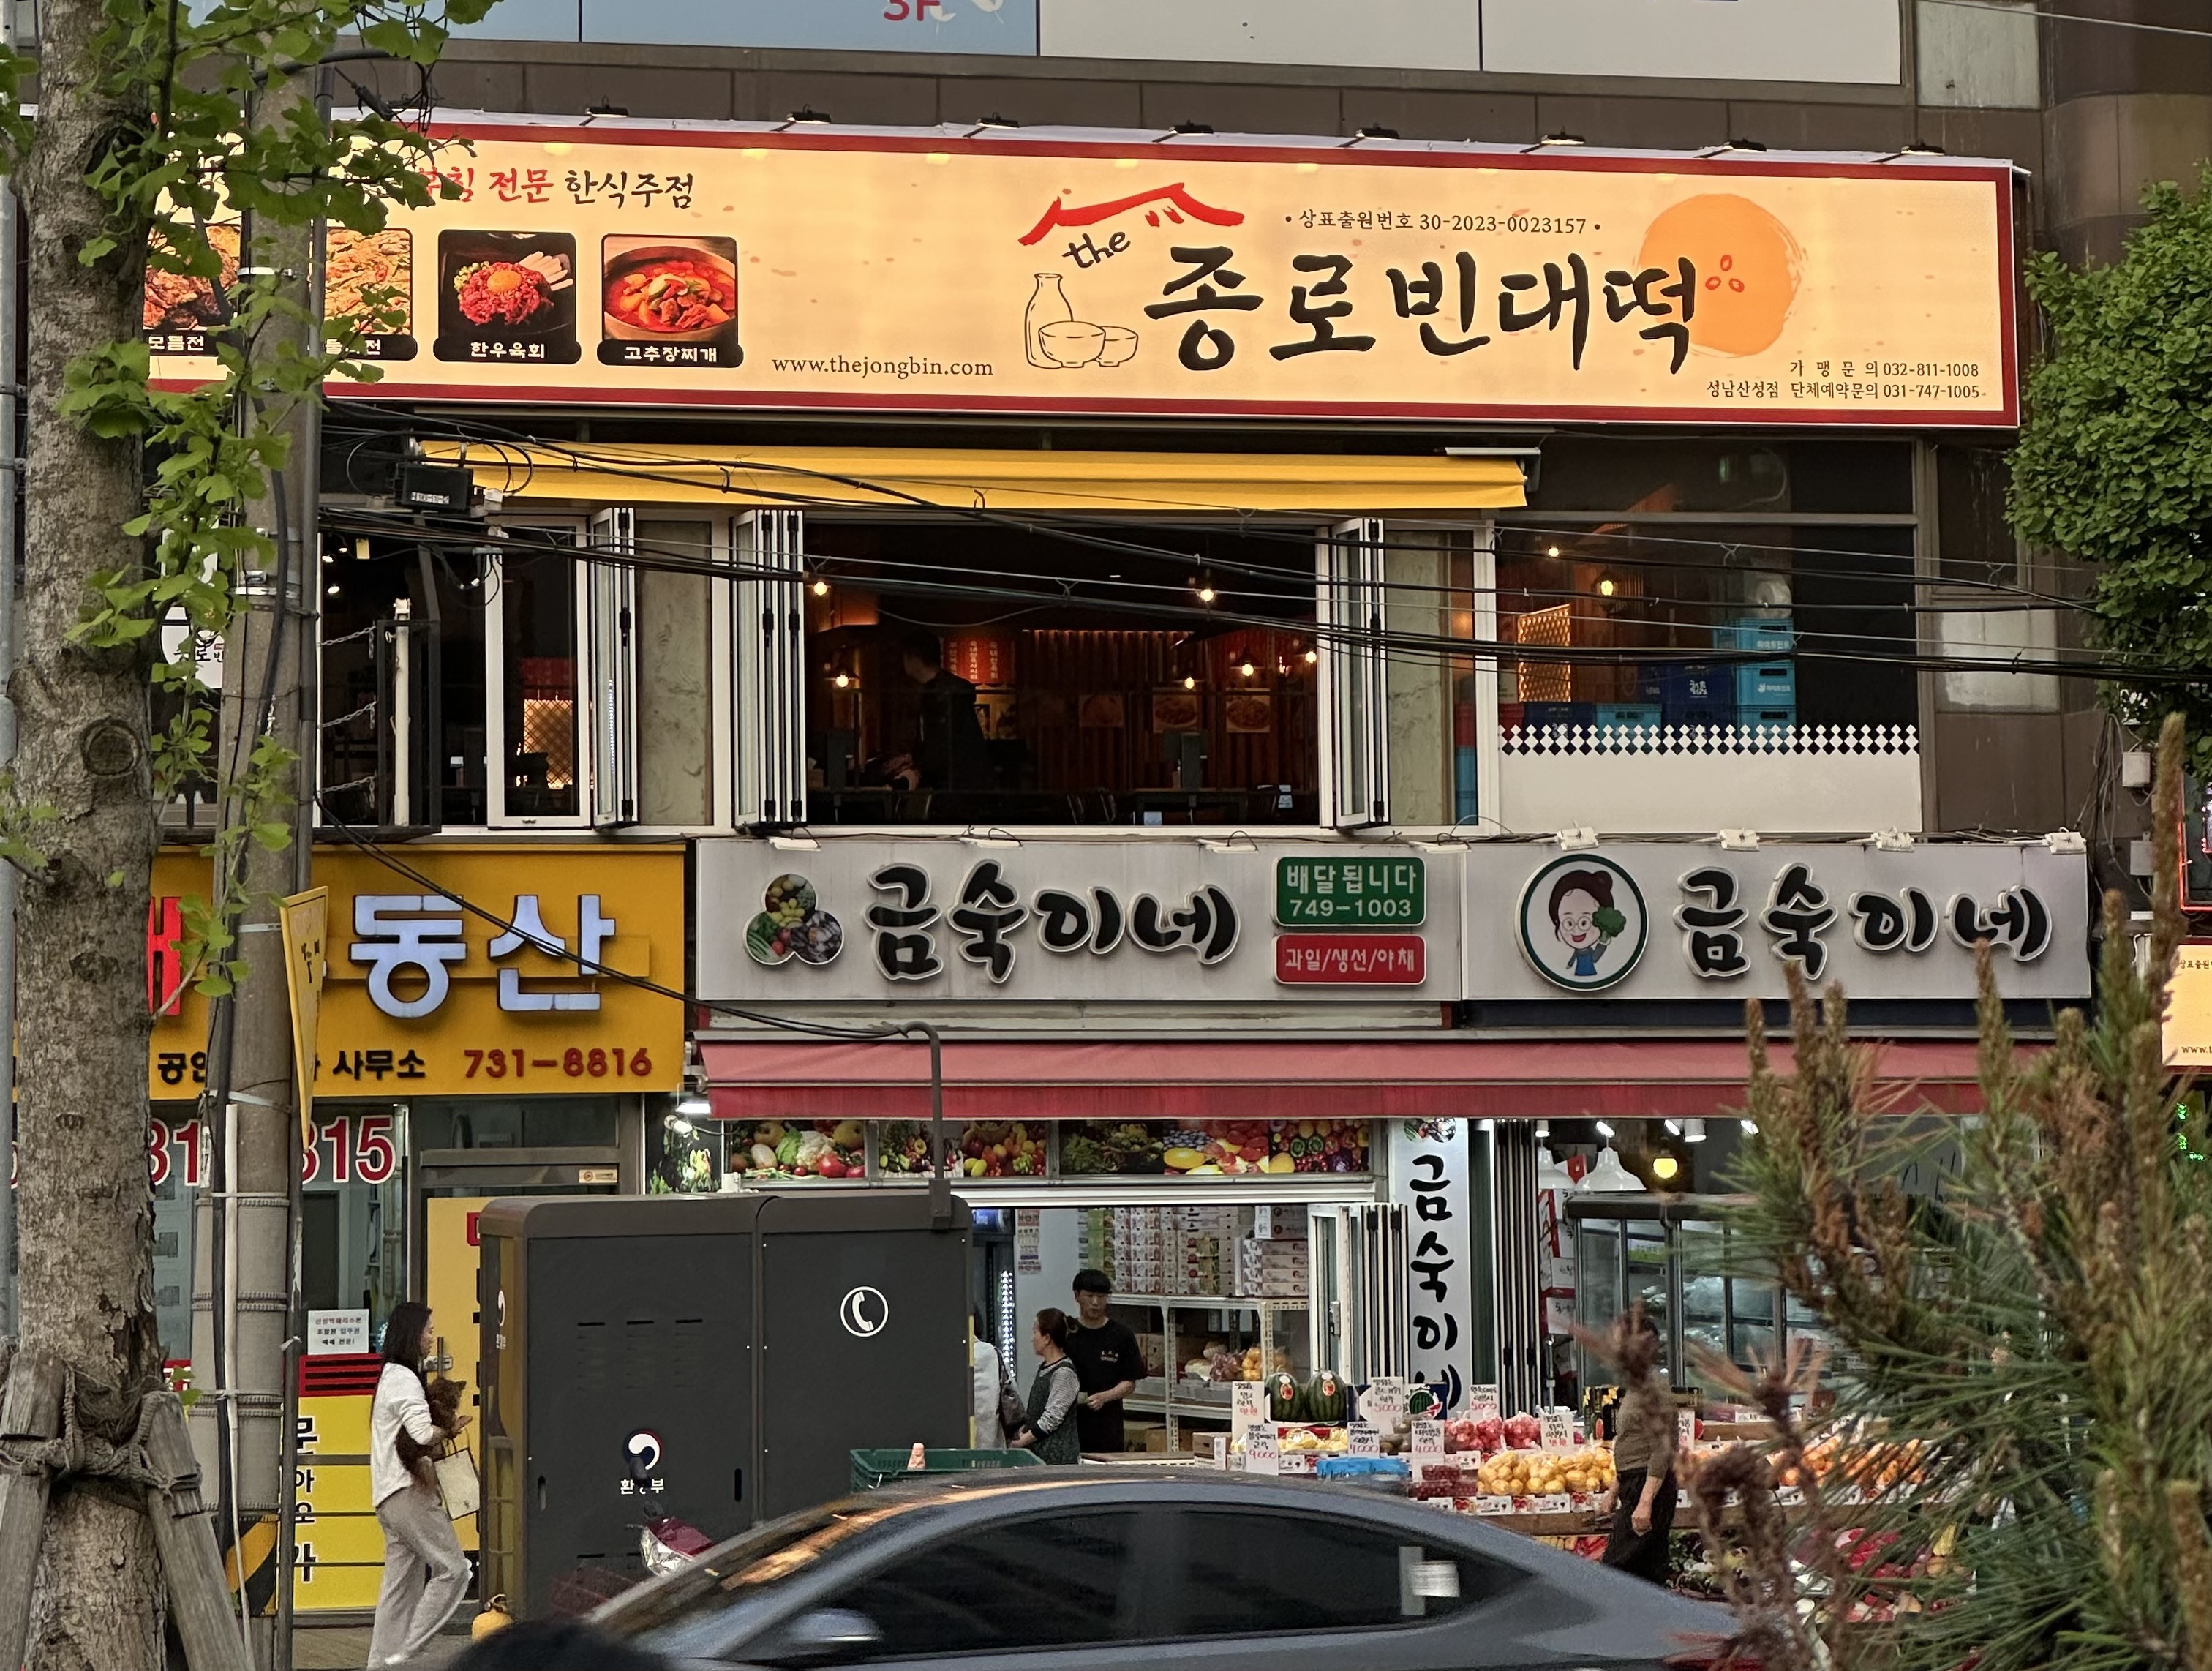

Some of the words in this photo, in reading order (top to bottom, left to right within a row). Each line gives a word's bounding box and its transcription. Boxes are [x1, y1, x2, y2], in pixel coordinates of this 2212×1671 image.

[488, 167, 554, 203] 전문
[565, 168, 694, 209] 한식주점
[1419, 214, 1586, 234] 30-2023-0023157
[1062, 231, 1131, 269] the
[1144, 245, 1696, 375] 종로빈대떡
[148, 335, 204, 351] 모듬전
[470, 340, 546, 359] 한우육회
[624, 345, 718, 364] 고추장찌개
[772, 356, 994, 379] www.thejongbin.com
[1883, 362, 1979, 377] 032-811-1008
[1707, 380, 1780, 398] 성남산성점
[1790, 381, 1878, 399] 단체예약문의
[1883, 384, 1980, 399] 031-747-1005
[1287, 865, 1417, 894] 배달됩니다
[1290, 899, 1412, 917] 749-1003
[864, 859, 1239, 983] 금숙이네
[1674, 863, 2051, 980] 금숙이네
[349, 893, 617, 1018] 동산
[1285, 948, 1415, 972] 과일/생선/야채
[332, 1048, 426, 1081] 사무소
[464, 1047, 652, 1079] 731-8816
[620, 1478, 664, 1495] 환부
